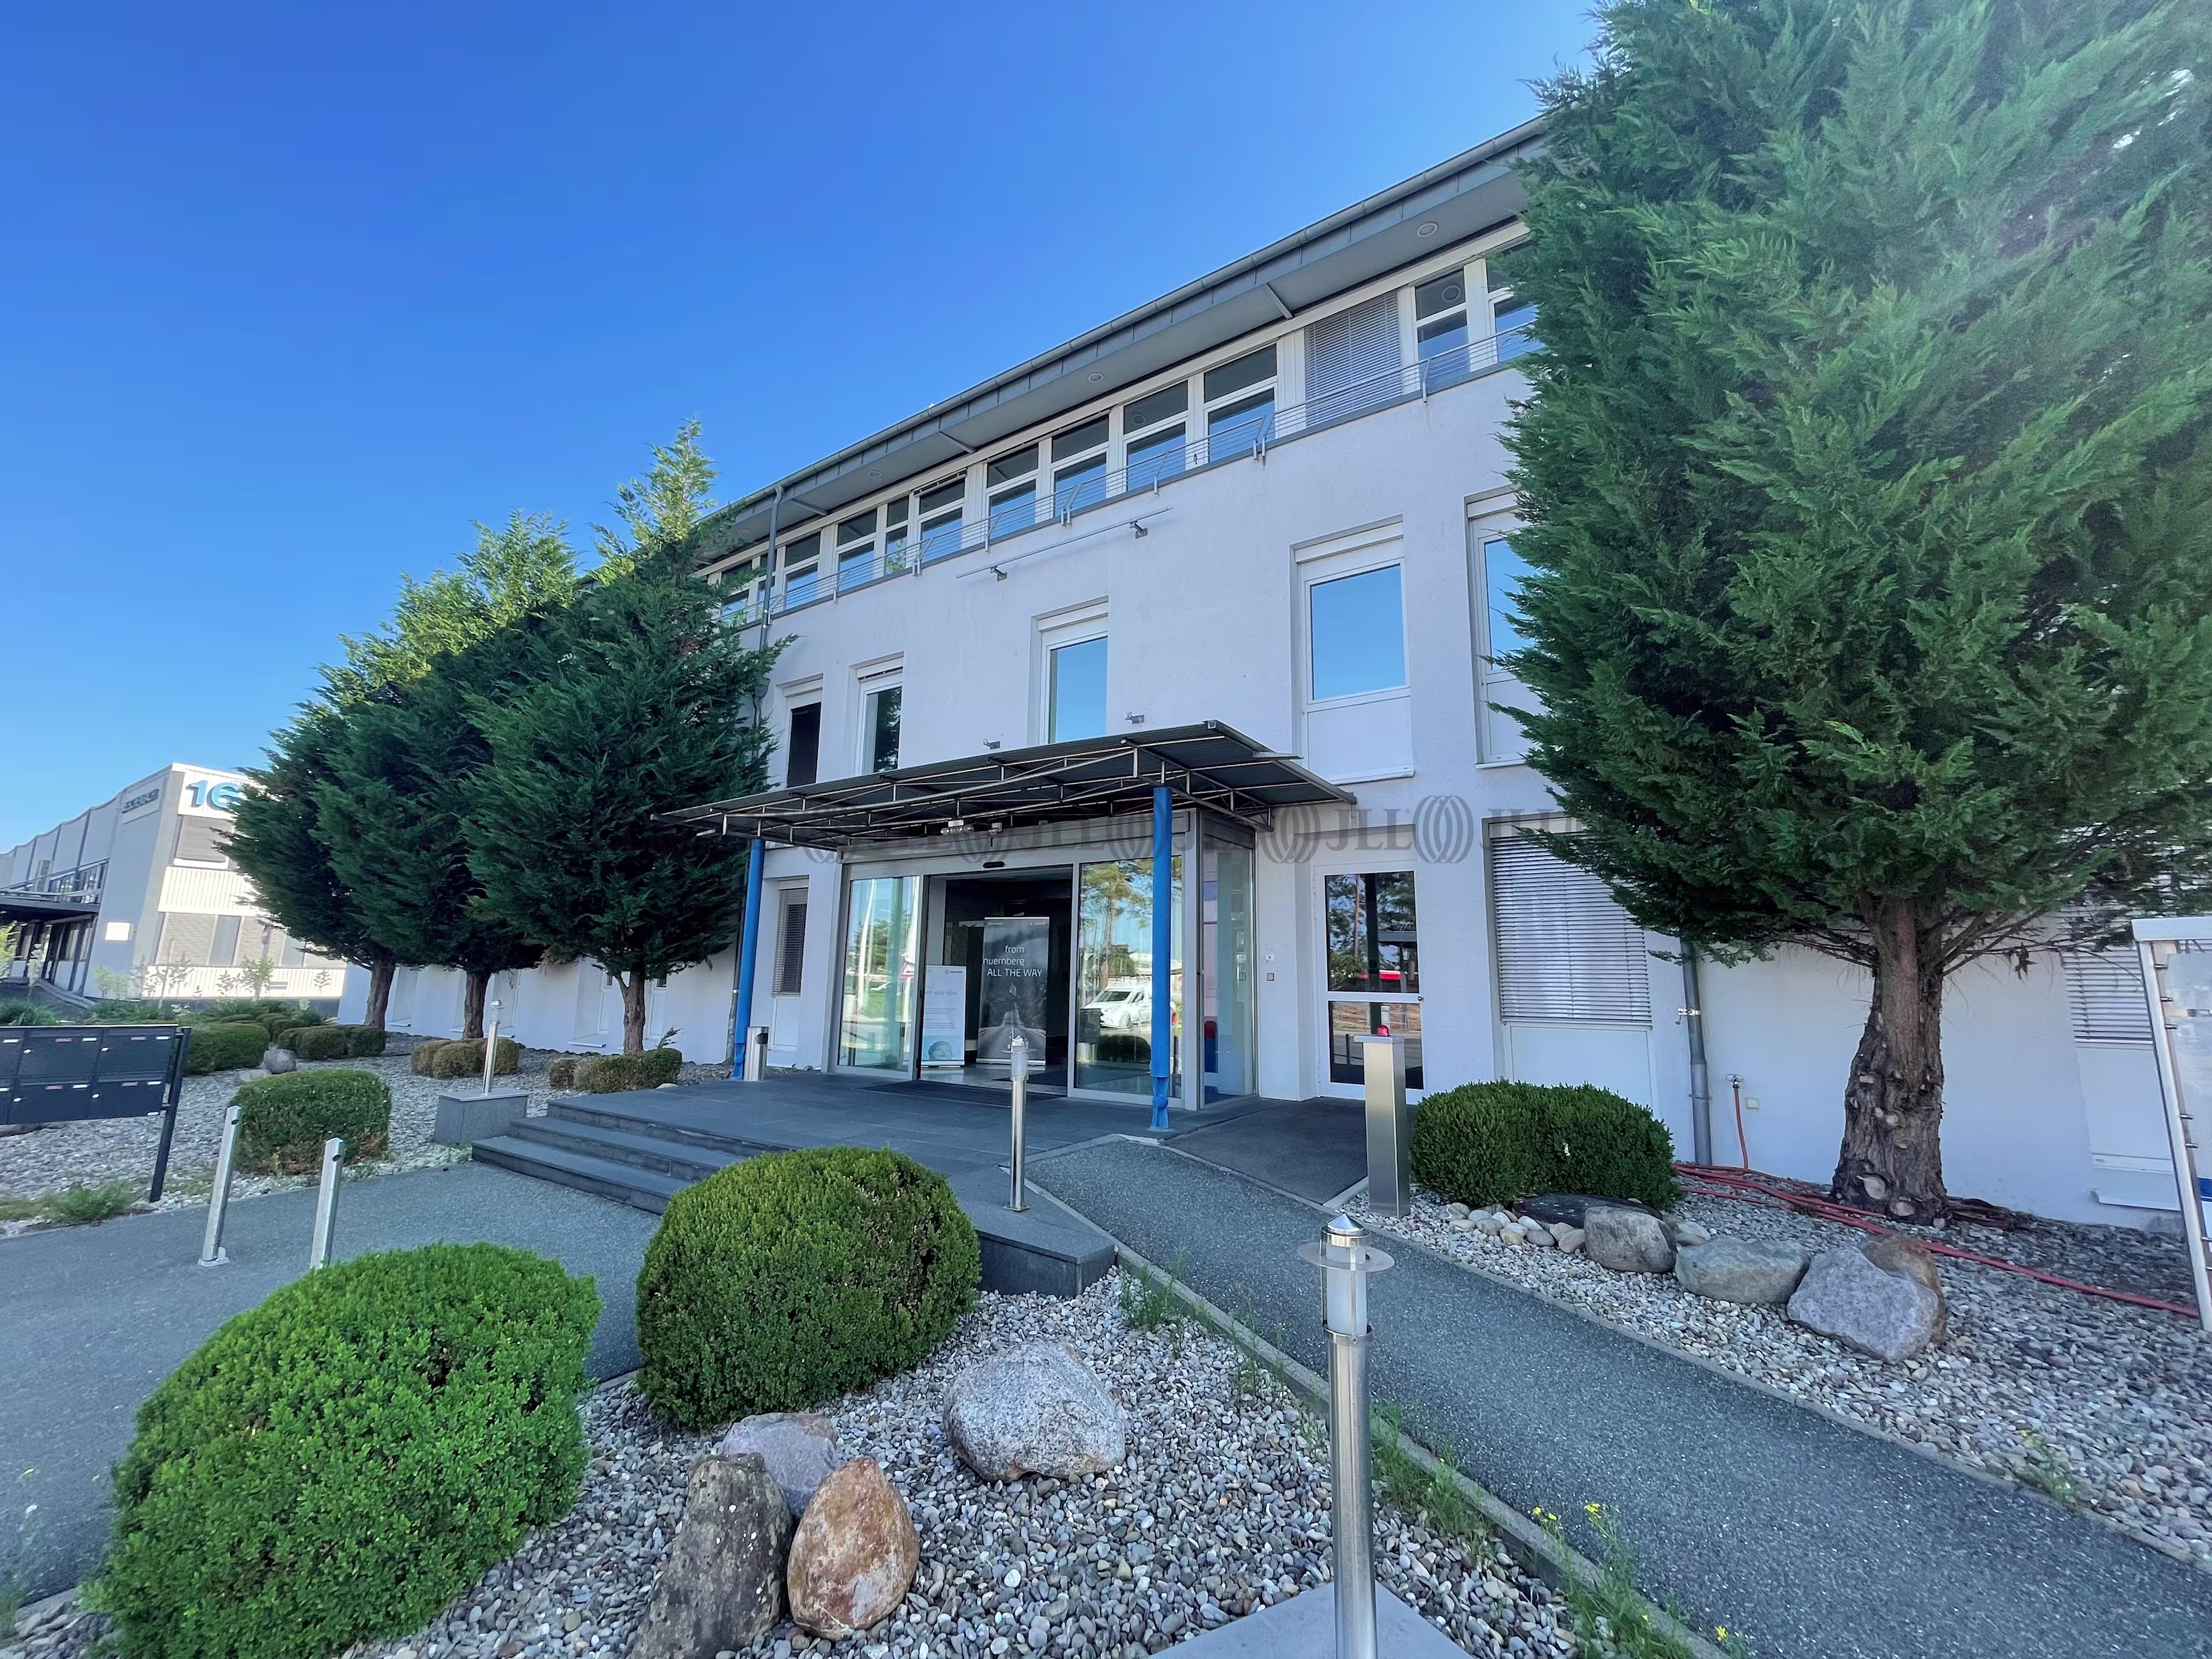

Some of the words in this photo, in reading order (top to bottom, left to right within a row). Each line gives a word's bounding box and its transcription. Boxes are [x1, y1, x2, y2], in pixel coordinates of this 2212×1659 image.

[1005, 945, 1025, 953] from
[983, 957, 1025, 967] nuernberg
[987, 968, 1002, 977] ALL
[1005, 968, 1021, 977] THE
[1023, 969, 1043, 978] WAY
